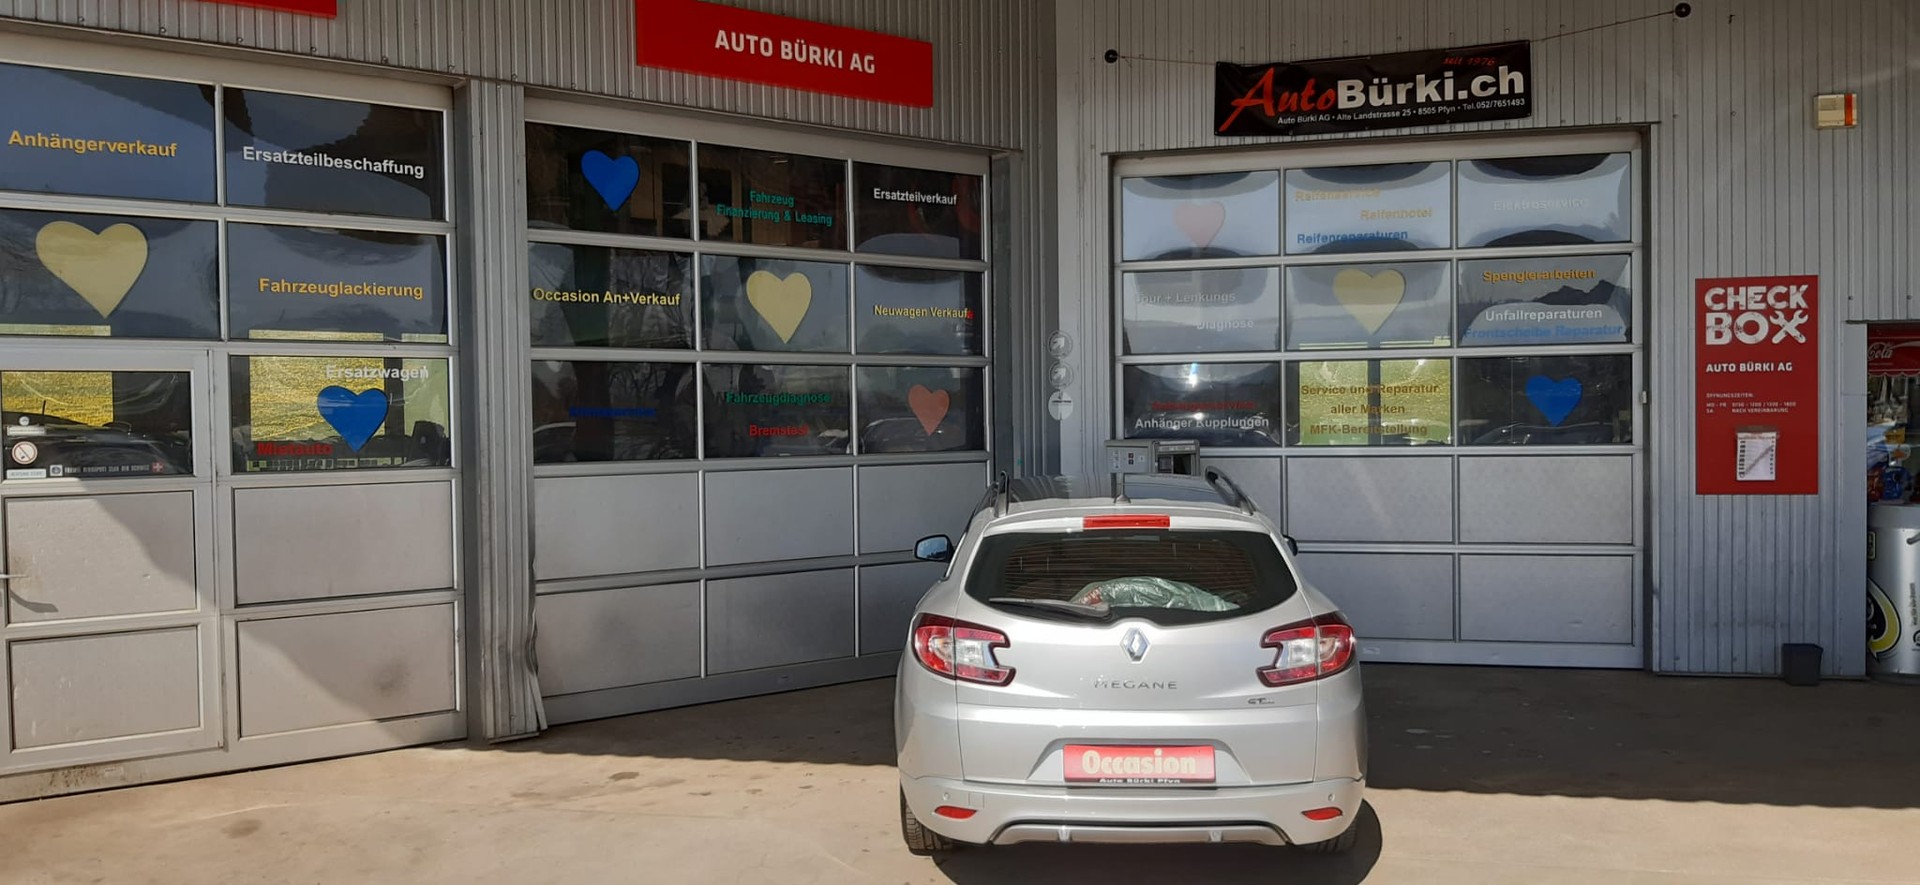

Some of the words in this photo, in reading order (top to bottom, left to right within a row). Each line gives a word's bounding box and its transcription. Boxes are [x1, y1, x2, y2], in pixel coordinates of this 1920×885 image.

[715, 30, 773, 57] AUTO
[780, 39, 843, 68] BÜRKI
[850, 53, 875, 74] AG
[1467, 57, 1496, 66] 1976
[1219, 65, 1524, 132] AutoBürki.ch
[1278, 117, 1295, 125] Auto
[1297, 115, 1317, 123] Bürki
[1318, 114, 1330, 122] AG
[1337, 113, 1352, 121] Alte
[1353, 110, 1400, 120] Landstrasse
[1402, 109, 1412, 117] 25
[1417, 107, 1436, 115] 8505
[1438, 105, 1456, 115] Pfyn
[8, 130, 177, 158] Anhängerverkauf
[243, 146, 424, 179] Ersatzteilbeschaffung
[750, 190, 794, 208] Fahrzeug
[873, 188, 957, 206] Ersatzteilverkauf
[716, 203, 780, 223] Finanzierung
[784, 210, 791, 222] &
[795, 211, 833, 227] Leasing
[1483, 268, 1596, 285] Spenglerarbeiten
[259, 277, 424, 301] Fahrzeuglackierung
[532, 287, 600, 303] Occasion
[603, 290, 681, 306] An+Verkauf
[1176, 291, 1237, 304] Lenkungs
[1704, 284, 1809, 311] CHECK
[873, 304, 928, 318] Neuwagen
[929, 306, 970, 319] Verkauf
[1485, 308, 1603, 323] Unfallreparaturen
[1197, 319, 1254, 332] Diagnose
[1556, 325, 1623, 339] Reparatur
[326, 363, 429, 382] Ersatzwagen
[1706, 362, 1736, 373] AUTO
[1739, 361, 1774, 372] BÜRKI
[1777, 362, 1793, 372] AG
[1301, 385, 1346, 395] Service
[1379, 383, 1439, 396] Reparatur
[726, 391, 832, 407] Fahrzeugdiagnose
[1331, 404, 1357, 414] aller
[1360, 404, 1406, 414] Marken
[750, 423, 810, 437] Bremstest
[1135, 417, 1193, 431] Anhänger
[1196, 416, 1270, 431] Kupplungen
[257, 440, 334, 456] Mietauto
[1093, 679, 1178, 691] MEGANE
[1081, 749, 1197, 775] Occasion
